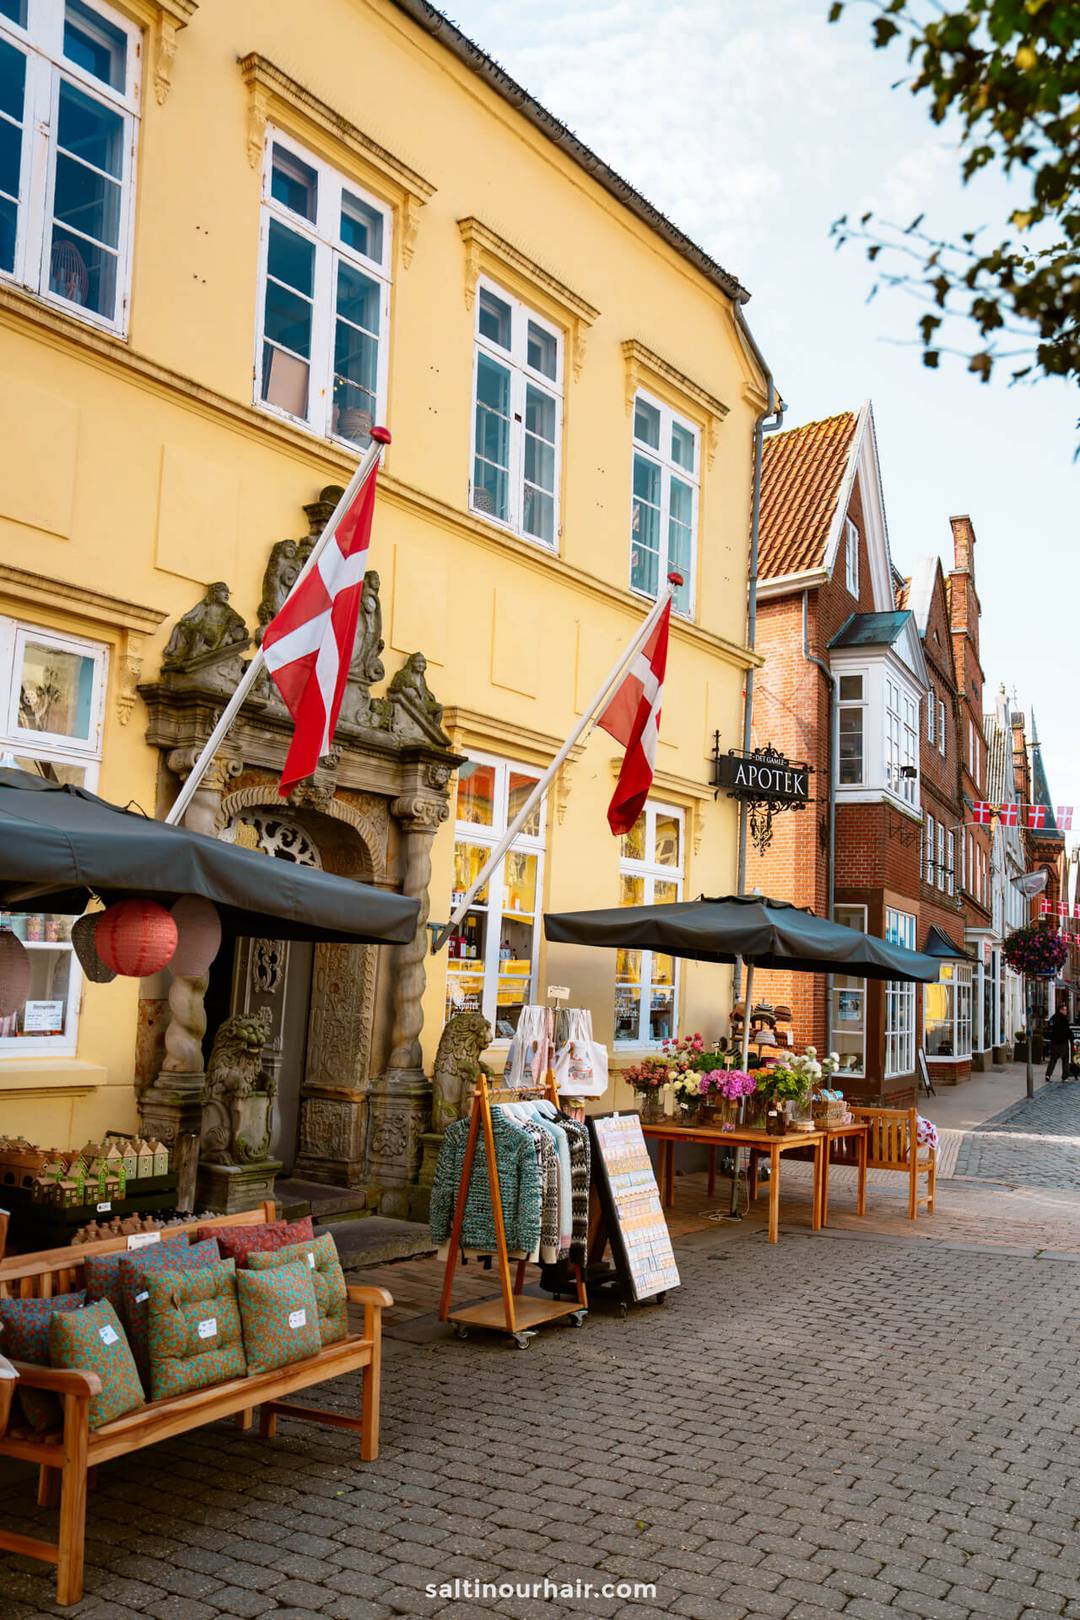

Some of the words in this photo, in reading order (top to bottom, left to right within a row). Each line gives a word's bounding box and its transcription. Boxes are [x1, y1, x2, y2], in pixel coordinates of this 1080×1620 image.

[755, 754, 766, 762] DET
[766, 757, 784, 765] GAMLE
[735, 763, 805, 796] APOTEK
